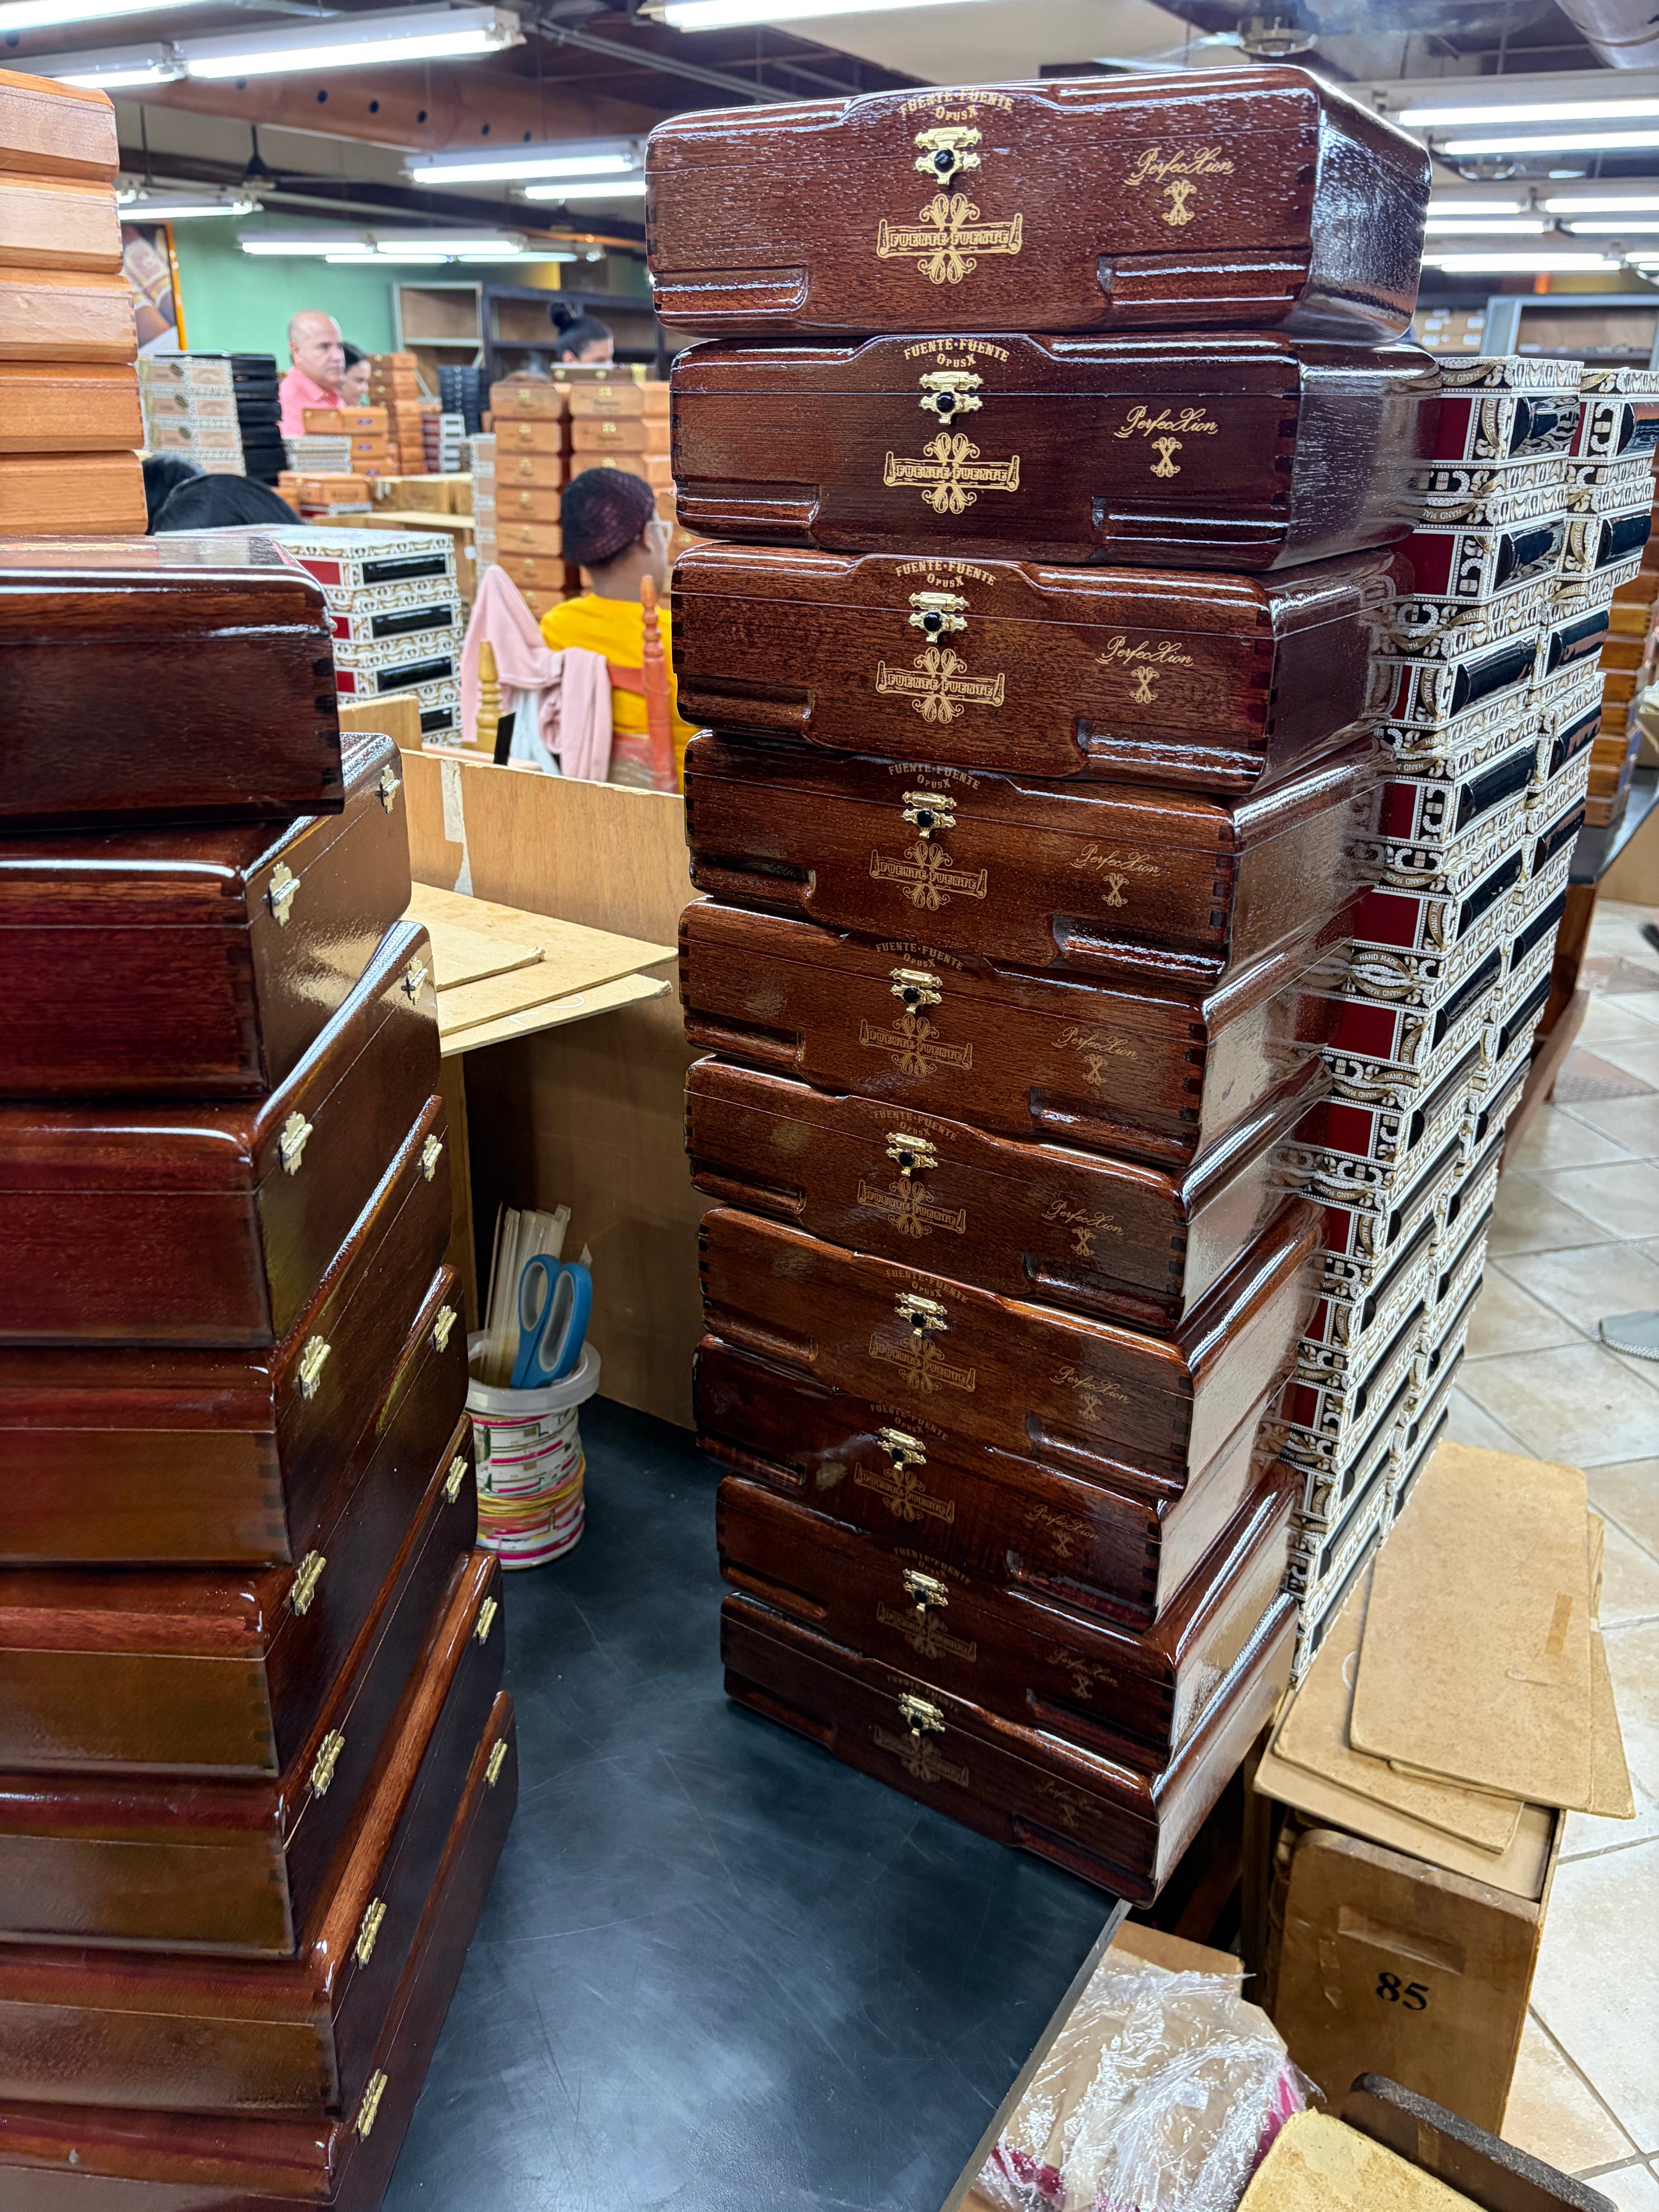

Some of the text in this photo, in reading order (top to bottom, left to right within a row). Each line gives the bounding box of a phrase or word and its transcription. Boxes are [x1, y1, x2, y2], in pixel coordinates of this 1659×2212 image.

[891, 230, 1009, 247] FUENTE FUENTE
[903, 338, 1010, 362] FUENTE FUENTE
[1457, 370, 1480, 382] HAND
[1484, 411, 1495, 434] MADE
[896, 465, 1007, 481] FUENTE FUENTE
[1440, 509, 1462, 520] HAND
[1573, 532, 1582, 551] MADE
[895, 560, 996, 586] FUENTE FUENTE
[1566, 585, 1585, 594] HAND
[888, 674, 993, 696] FUENTE FUENTE
[1423, 683, 1432, 703] MADE
[1403, 763, 1423, 771] HAND
[888, 763, 980, 790] FUENTE FUENTE
[880, 863, 976, 889] FUENTE FUENTE
[1385, 872, 1425, 885] HAND MADE
[876, 942, 964, 970] FUENTE FUENTE
[1380, 955, 1398, 967] MADE
[1363, 983, 1380, 995] MADE
[869, 1030, 963, 1061] FUENTE FUENTE
[1404, 1036, 1415, 1052] MADE
[1339, 1084, 1356, 1096] MADE
[1318, 1184, 1335, 1196] MADE
[1361, 1226, 1369, 1244] MADE
[1376, 1972, 1429, 2010] 85
